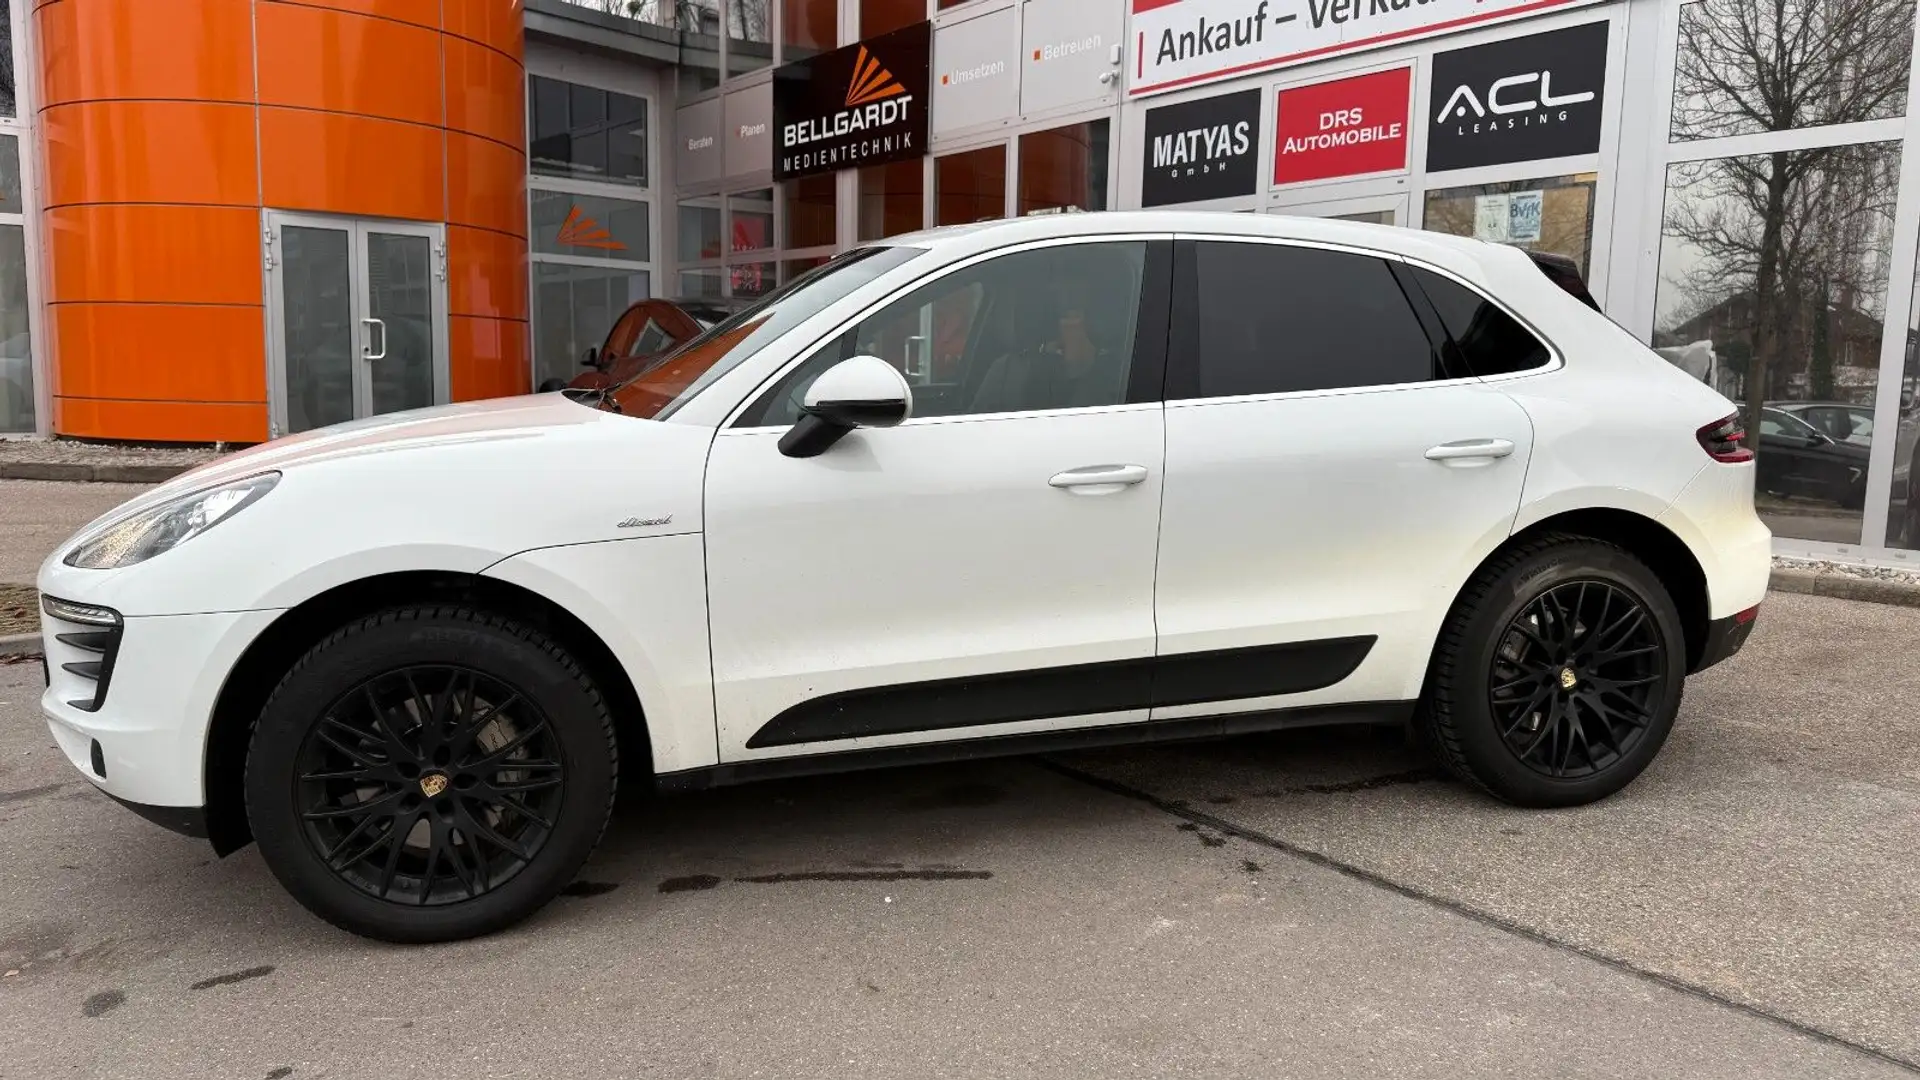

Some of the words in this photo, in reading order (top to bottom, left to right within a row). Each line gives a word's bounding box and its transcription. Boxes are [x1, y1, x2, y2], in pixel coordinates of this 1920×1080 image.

[1043, 34, 1101, 60] Betreuen
[1156, 1, 1268, 66] Ankauf
[951, 60, 1004, 85] Umsetzen
[1437, 70, 1595, 124] ACL
[741, 123, 766, 138] Planen
[784, 95, 912, 147] BELLGARDT
[1320, 107, 1363, 130] DRS
[1458, 110, 1568, 136] LEASING
[783, 131, 912, 172] MEDIENTECHNIK
[1153, 121, 1249, 168] MATYAS
[1282, 123, 1401, 154] AUTOMOBILE
